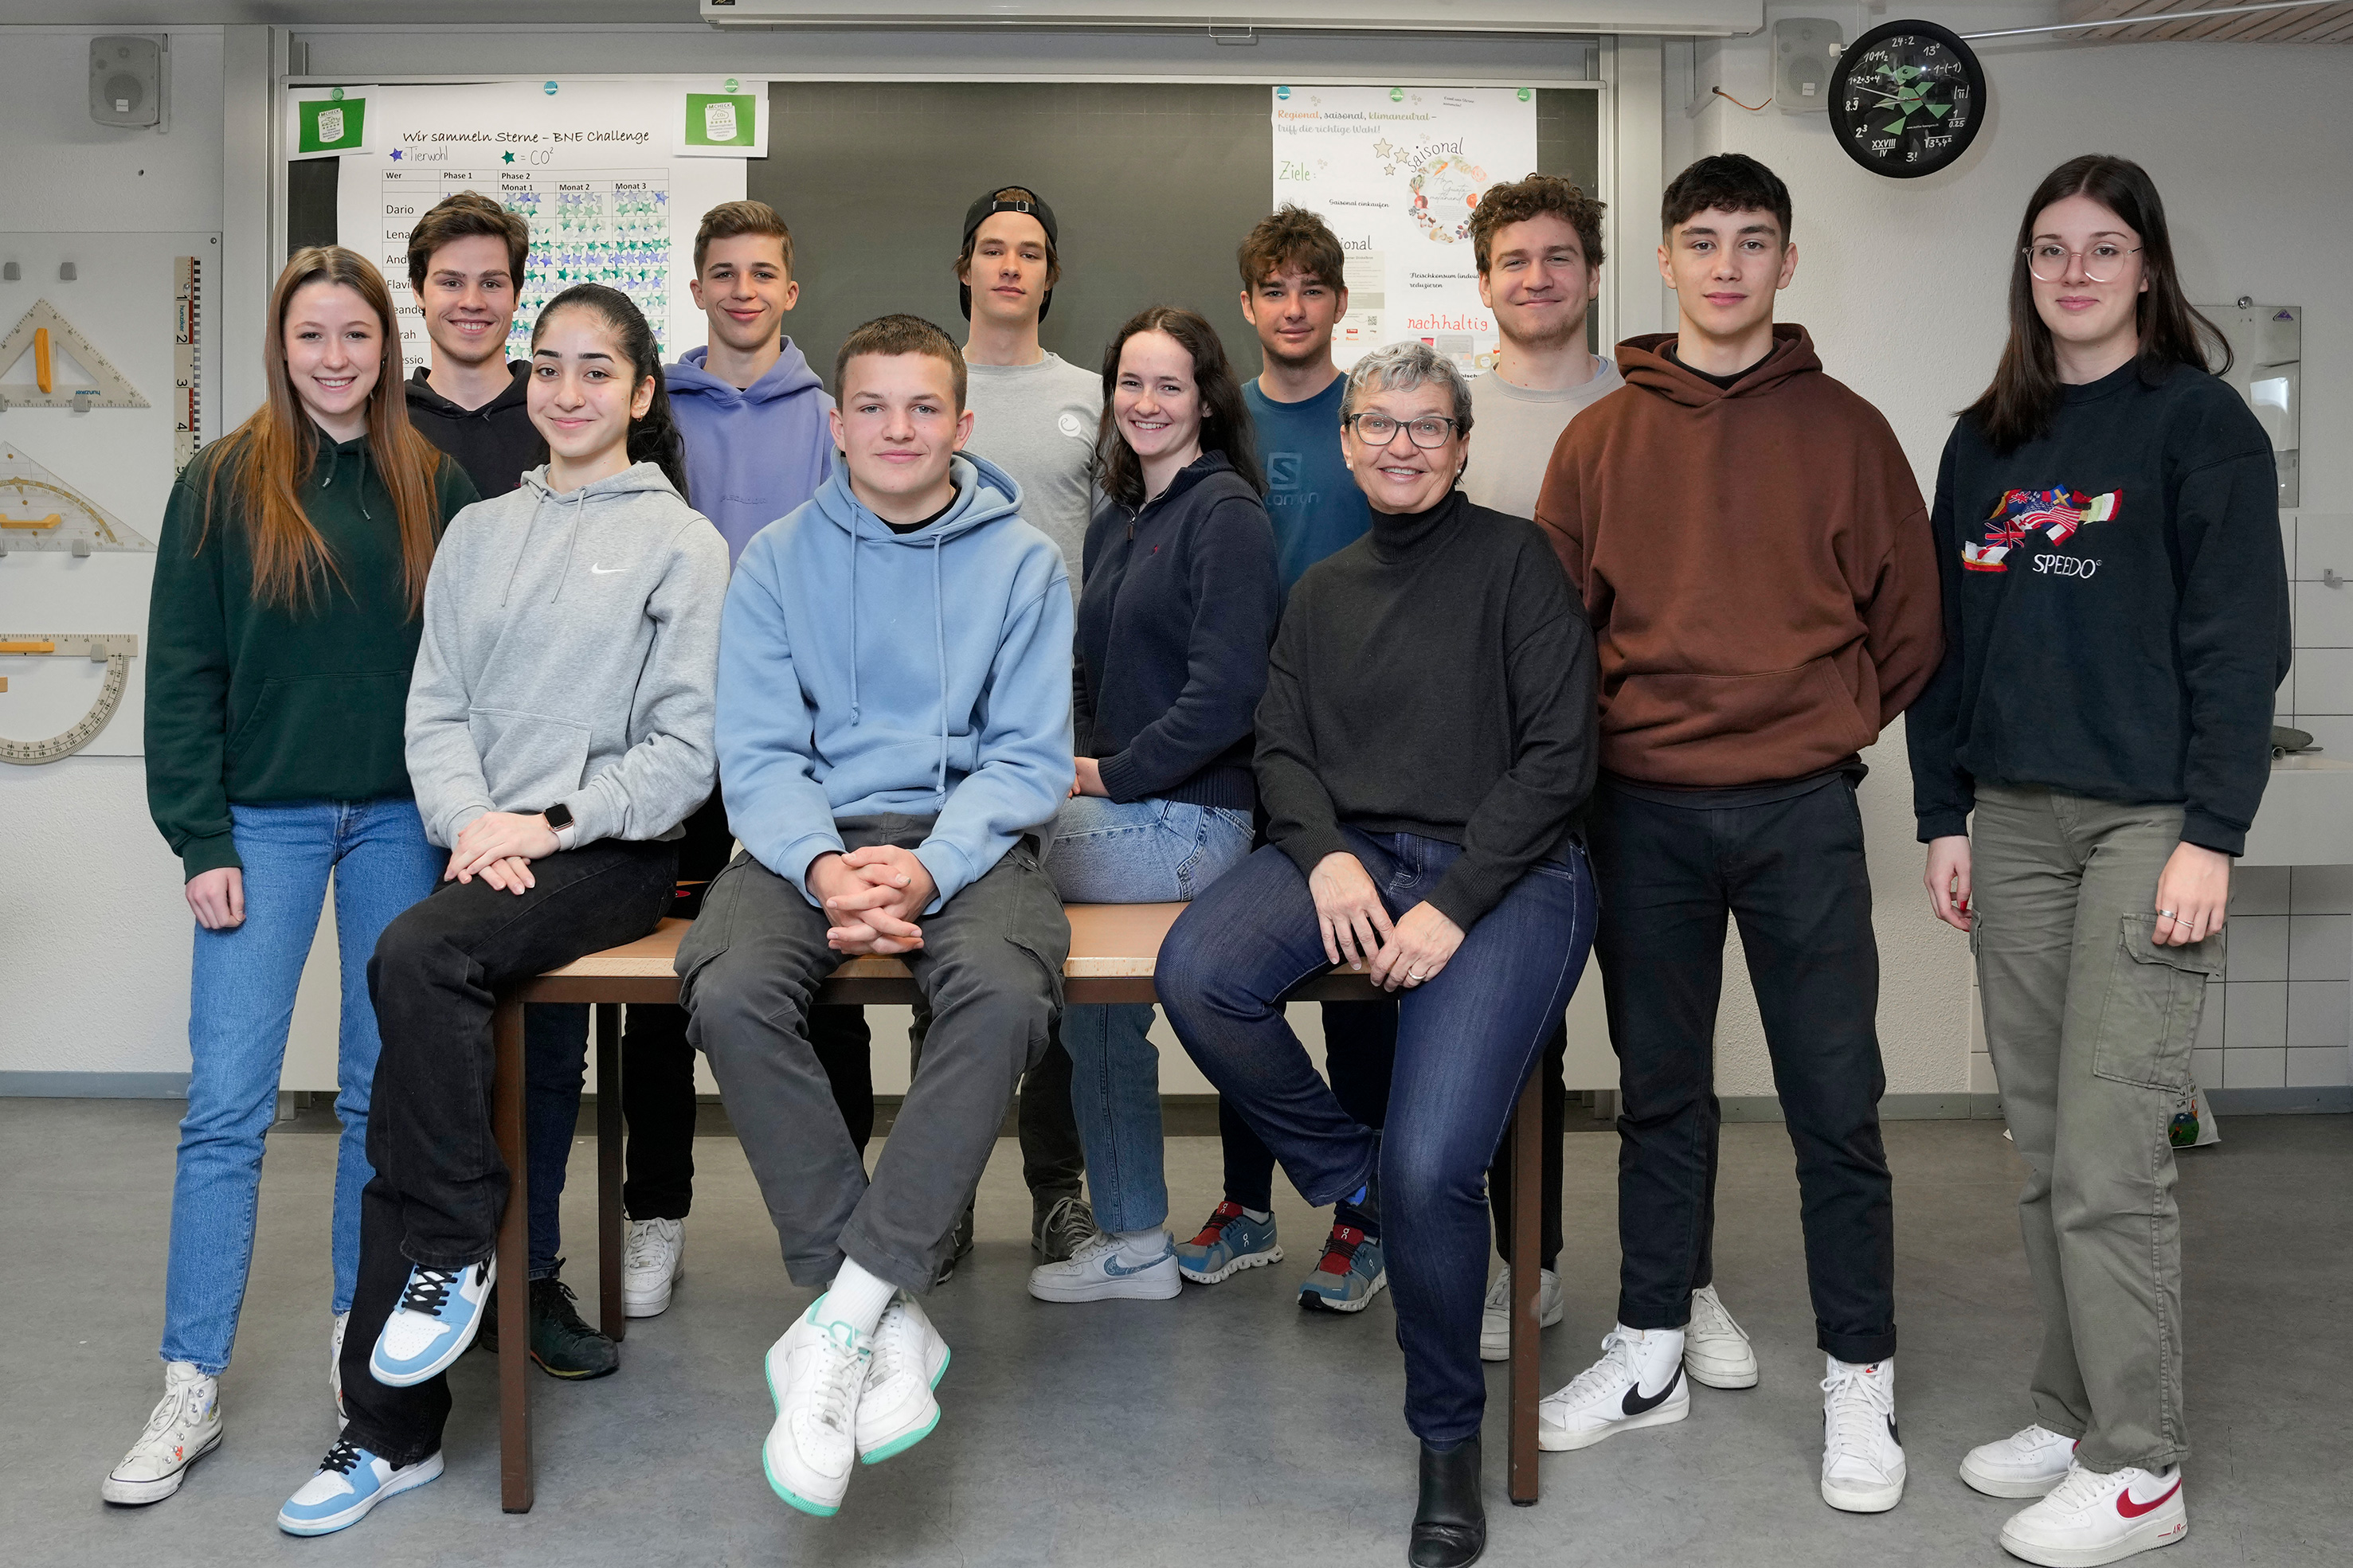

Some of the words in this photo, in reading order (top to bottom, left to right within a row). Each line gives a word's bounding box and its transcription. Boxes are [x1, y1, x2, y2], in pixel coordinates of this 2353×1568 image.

[1892, 36, 1915, 47] 24:2
[1278, 110, 1322, 121] Regional,
[1324, 111, 1366, 120] saisonal,
[1368, 111, 1430, 121] klimaneutral
[1278, 124, 1298, 135] triff
[1299, 124, 1314, 133] die
[1315, 126, 1351, 135] richtige
[1353, 125, 1380, 134] Wahl!
[403, 131, 428, 142] Wir
[431, 131, 492, 142] sammeln
[495, 132, 538, 143] Sterne
[553, 132, 583, 143] BNE
[587, 131, 649, 144] Challenge
[1872, 139, 1896, 148] XXVIII
[405, 145, 448, 162] Tierwohl
[1407, 137, 1464, 174] saisonal
[1879, 149, 1888, 158] IV
[1905, 151, 1918, 162] 3!
[386, 205, 414, 214] Dario
[386, 229, 411, 239] Lena
[1340, 235, 1372, 250] ional
[386, 255, 409, 264] And
[394, 304, 423, 314] eande
[1407, 314, 1488, 331] nachhaltig
[176, 334, 188, 343] 2
[400, 330, 417, 338] rah
